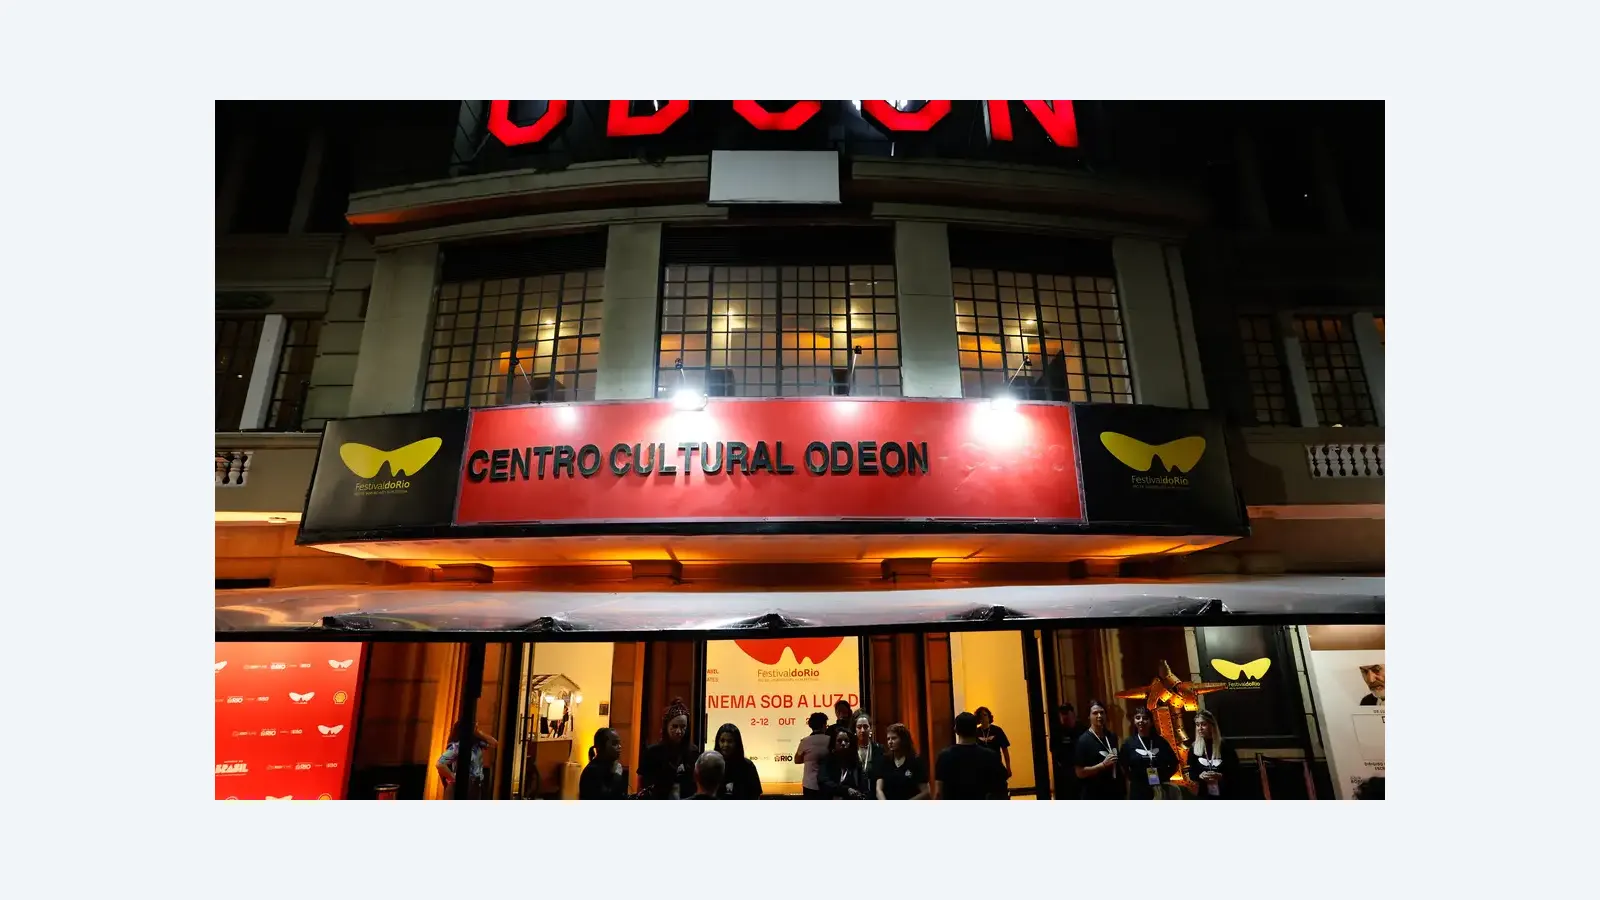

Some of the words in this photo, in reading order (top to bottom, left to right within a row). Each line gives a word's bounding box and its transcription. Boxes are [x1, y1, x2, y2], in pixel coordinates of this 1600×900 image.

[468, 444, 601, 482] CENTRO
[609, 441, 795, 477] CULTURAL
[804, 441, 929, 477] ODEON
[1131, 475, 1189, 485] FestivaldoRio
[355, 480, 410, 491] FestivaldoRio
[757, 668, 820, 678] FestivaldoRio
[708, 695, 756, 709] NEMA
[760, 694, 793, 708] SOB
[797, 694, 809, 708] A
[750, 718, 769, 726] 2-12
[778, 717, 796, 726] OUT
